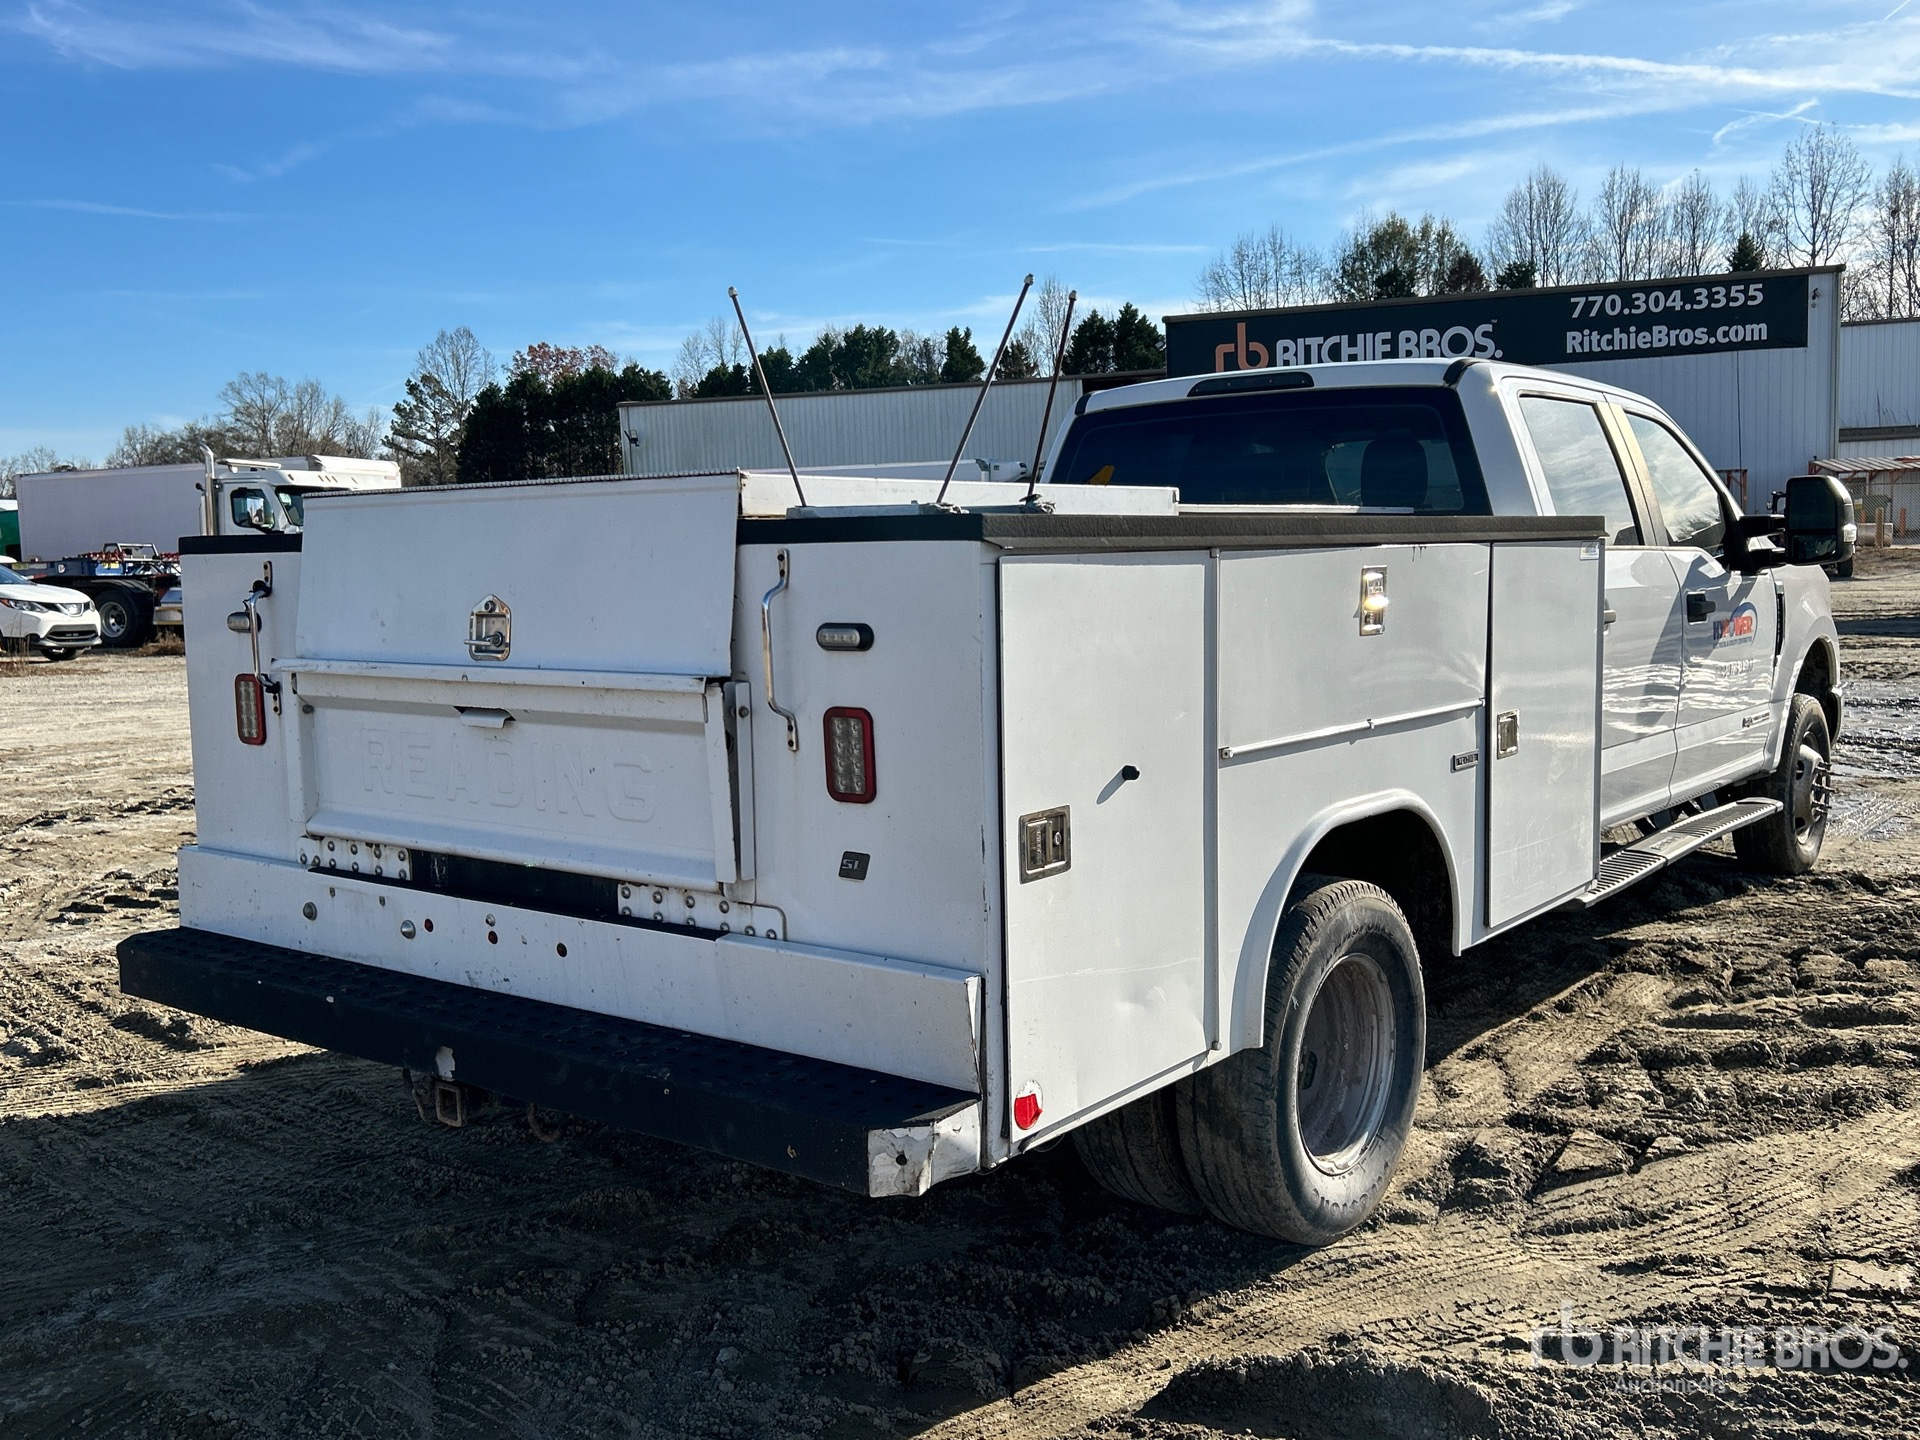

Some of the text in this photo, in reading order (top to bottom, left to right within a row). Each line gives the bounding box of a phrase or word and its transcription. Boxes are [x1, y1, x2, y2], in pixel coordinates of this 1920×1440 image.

[1570, 283, 1764, 318] 770.304.3355
[1276, 332, 1391, 367] RITCHIE
[1399, 324, 1503, 359] BROS.
[1566, 323, 1768, 353] RitchieBros.com
[360, 727, 655, 823] READING
